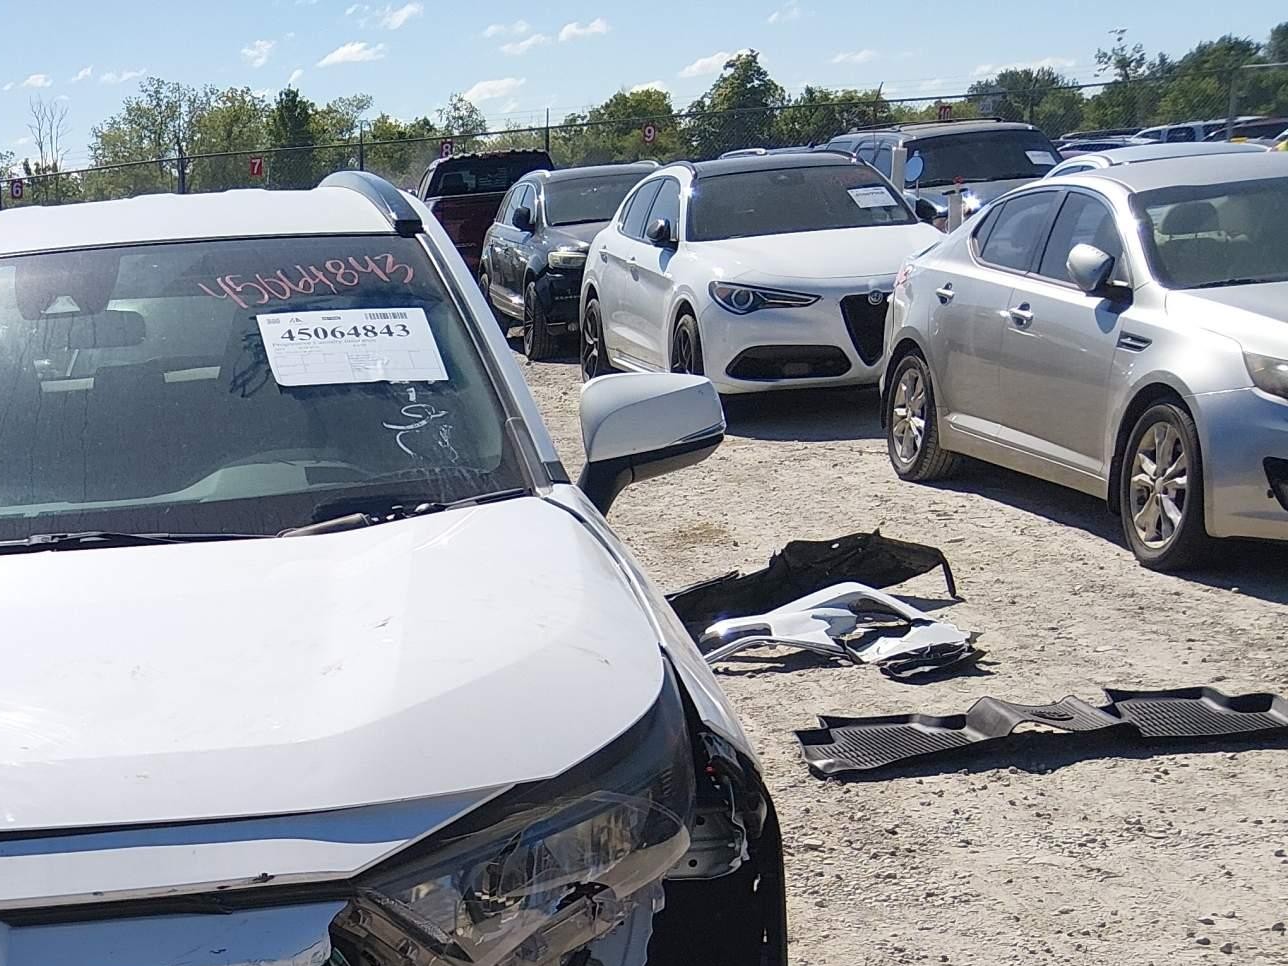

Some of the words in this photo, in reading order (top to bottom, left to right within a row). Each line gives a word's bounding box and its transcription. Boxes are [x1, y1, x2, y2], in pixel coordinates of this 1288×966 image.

[644, 126, 655, 141] 9
[442, 143, 452, 157] 8
[251, 158, 261, 174] 7
[12, 182, 22, 197] 6
[198, 253, 413, 309] 45064843
[280, 323, 411, 342] 45064843
